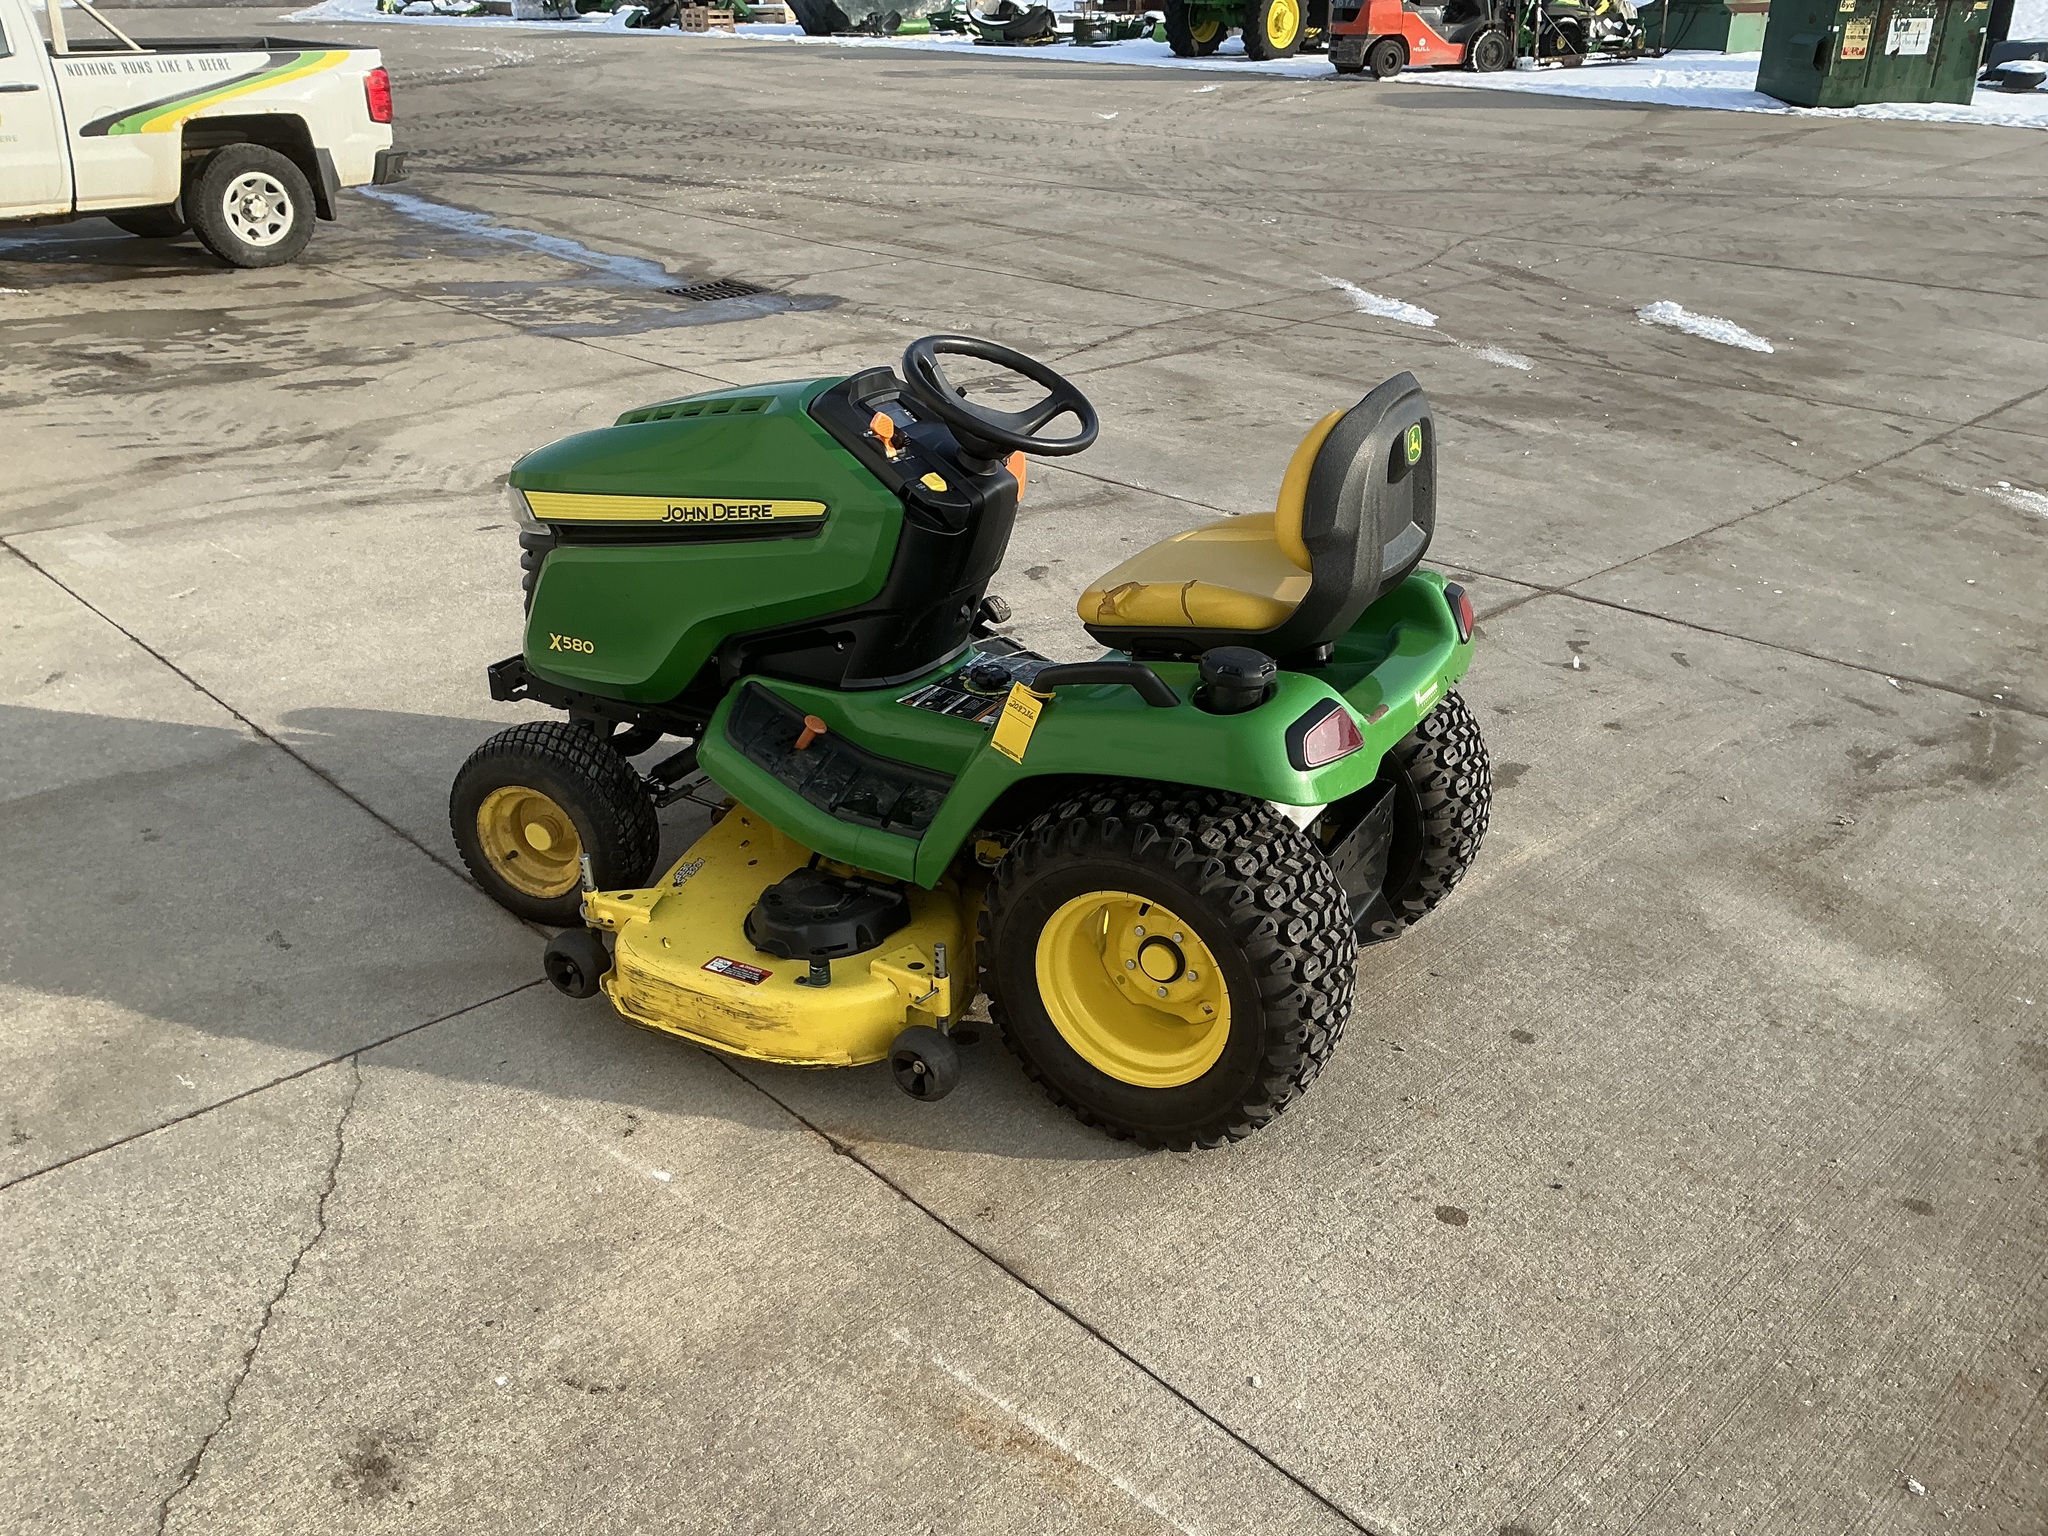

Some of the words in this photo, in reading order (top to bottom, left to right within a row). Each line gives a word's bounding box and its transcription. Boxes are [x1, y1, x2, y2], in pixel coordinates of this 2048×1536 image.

[65, 62, 117, 77] NOTHING
[121, 61, 153, 74] RUNS
[156, 60, 182, 73] LIKE
[186, 59, 195, 72] A
[199, 58, 231, 71] DEERE
[662, 504, 709, 520] JOHN
[712, 503, 772, 519] DEERE
[549, 632, 594, 654] X580
